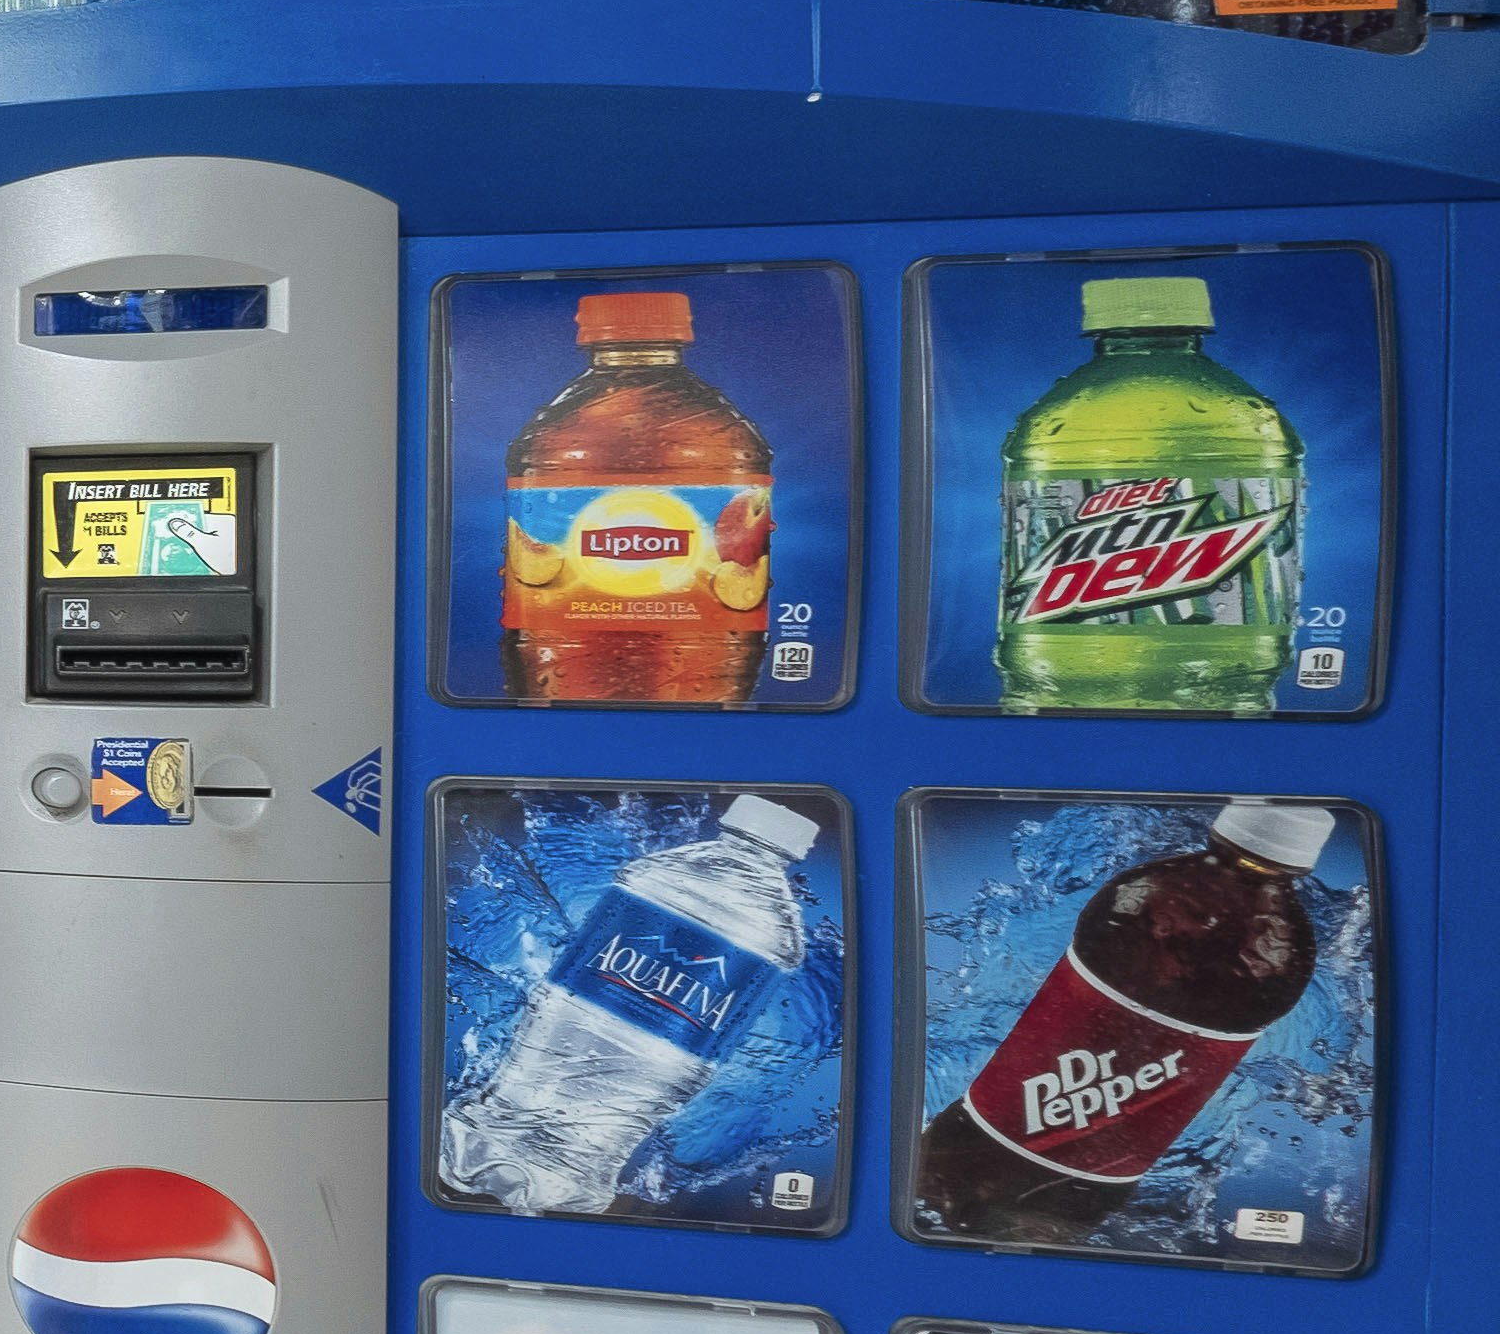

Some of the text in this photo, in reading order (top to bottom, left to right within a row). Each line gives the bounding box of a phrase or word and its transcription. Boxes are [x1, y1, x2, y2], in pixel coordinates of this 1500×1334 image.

[68, 480, 210, 501] INSERT BILL HERE
[1079, 478, 1180, 519] diet
[83, 512, 129, 525] ACCEPTS
[95, 525, 128, 537] BILLS
[1046, 510, 1190, 565] Mtn
[589, 532, 681, 555] Lipton
[1023, 519, 1268, 617] DEW
[570, 601, 697, 614] PEACH ICED TEA
[776, 602, 813, 623] 20
[1306, 606, 1347, 628] 20
[779, 646, 810, 664] 120
[1312, 652, 1334, 670] 10
[96, 739, 149, 750] Presidential
[117, 748, 143, 758] Coins
[100, 757, 147, 768] Accepted
[584, 933, 730, 1033] AQUAFINA
[1056, 1049, 1119, 1087] Dr
[1021, 1045, 1183, 1136] Pepper
[787, 1178, 799, 1195] 0
[1254, 1211, 1289, 1225] 250
